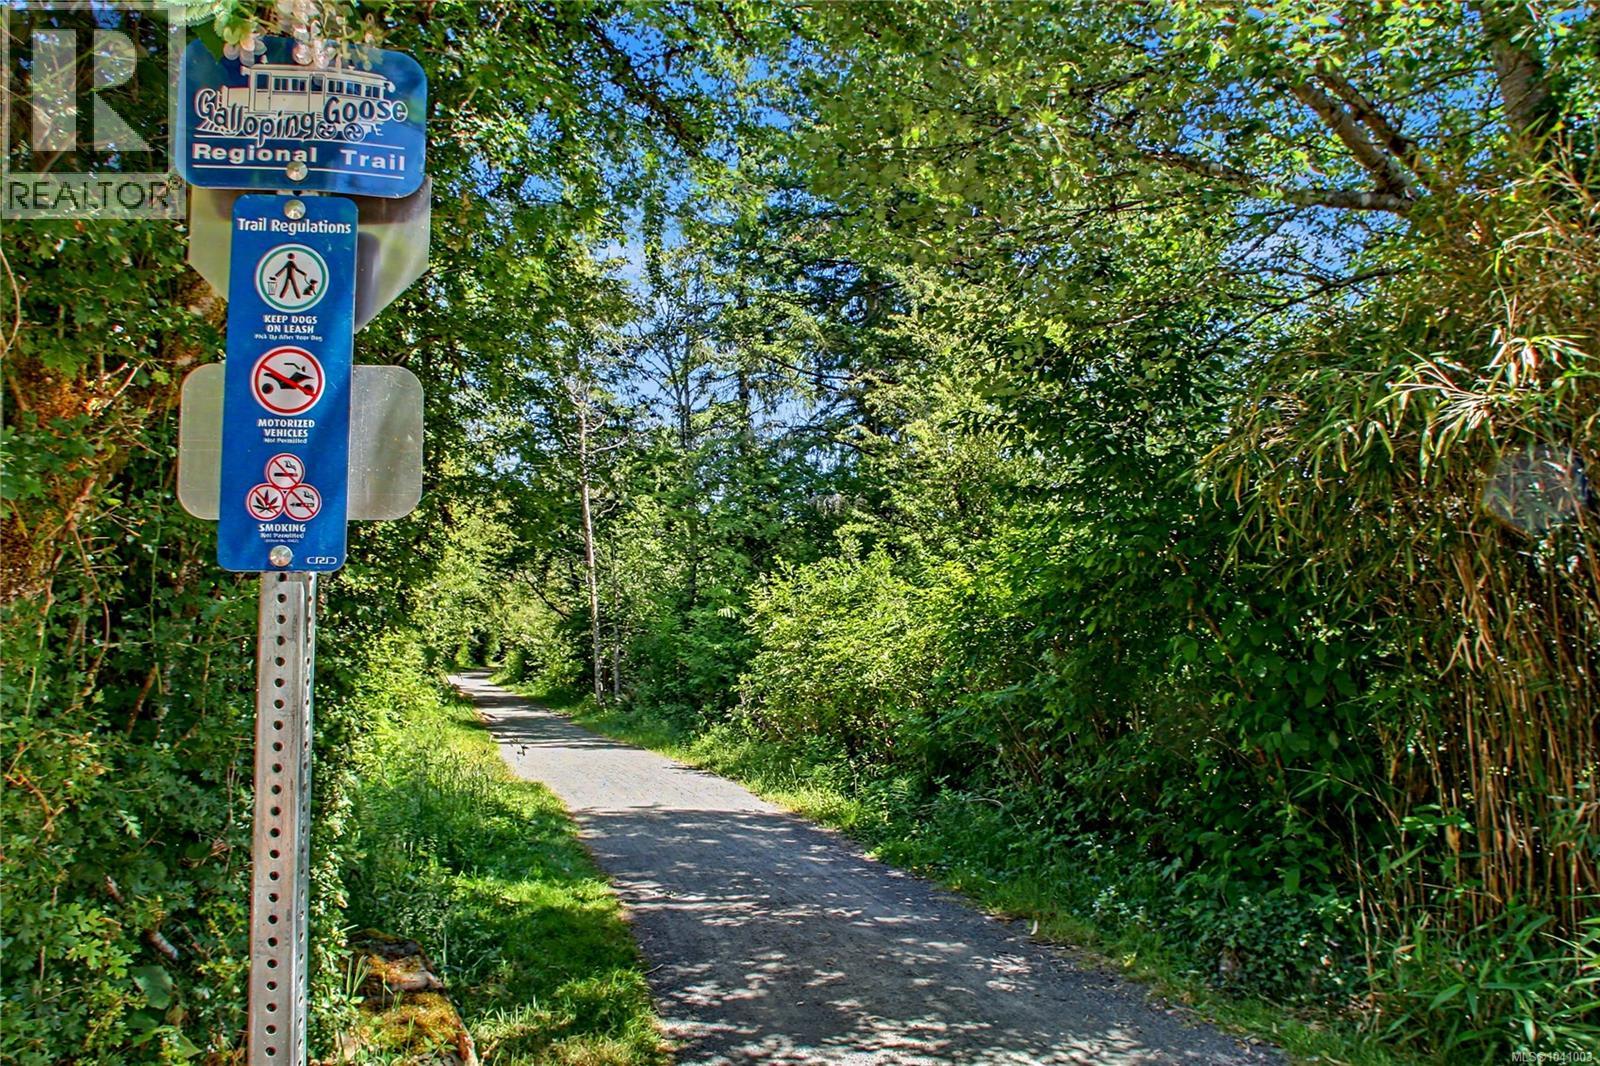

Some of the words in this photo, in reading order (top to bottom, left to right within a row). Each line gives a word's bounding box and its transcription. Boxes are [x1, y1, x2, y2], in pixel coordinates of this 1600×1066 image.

[195, 88, 316, 148] Galloping
[323, 95, 408, 130] Goose
[192, 143, 317, 164] Regional
[341, 149, 405, 171] Trail
[237, 218, 267, 232] Trail
[271, 219, 352, 236] Regulations
[264, 315, 289, 324] KEEP
[291, 316, 318, 324] DOGS
[266, 325, 281, 333] ON
[284, 325, 314, 334] LEASH
[257, 419, 315, 428] MOTORIZED
[264, 429, 308, 438] VEHICLES
[258, 523, 306, 533] SMOKING
[306, 556, 338, 565] CRD
